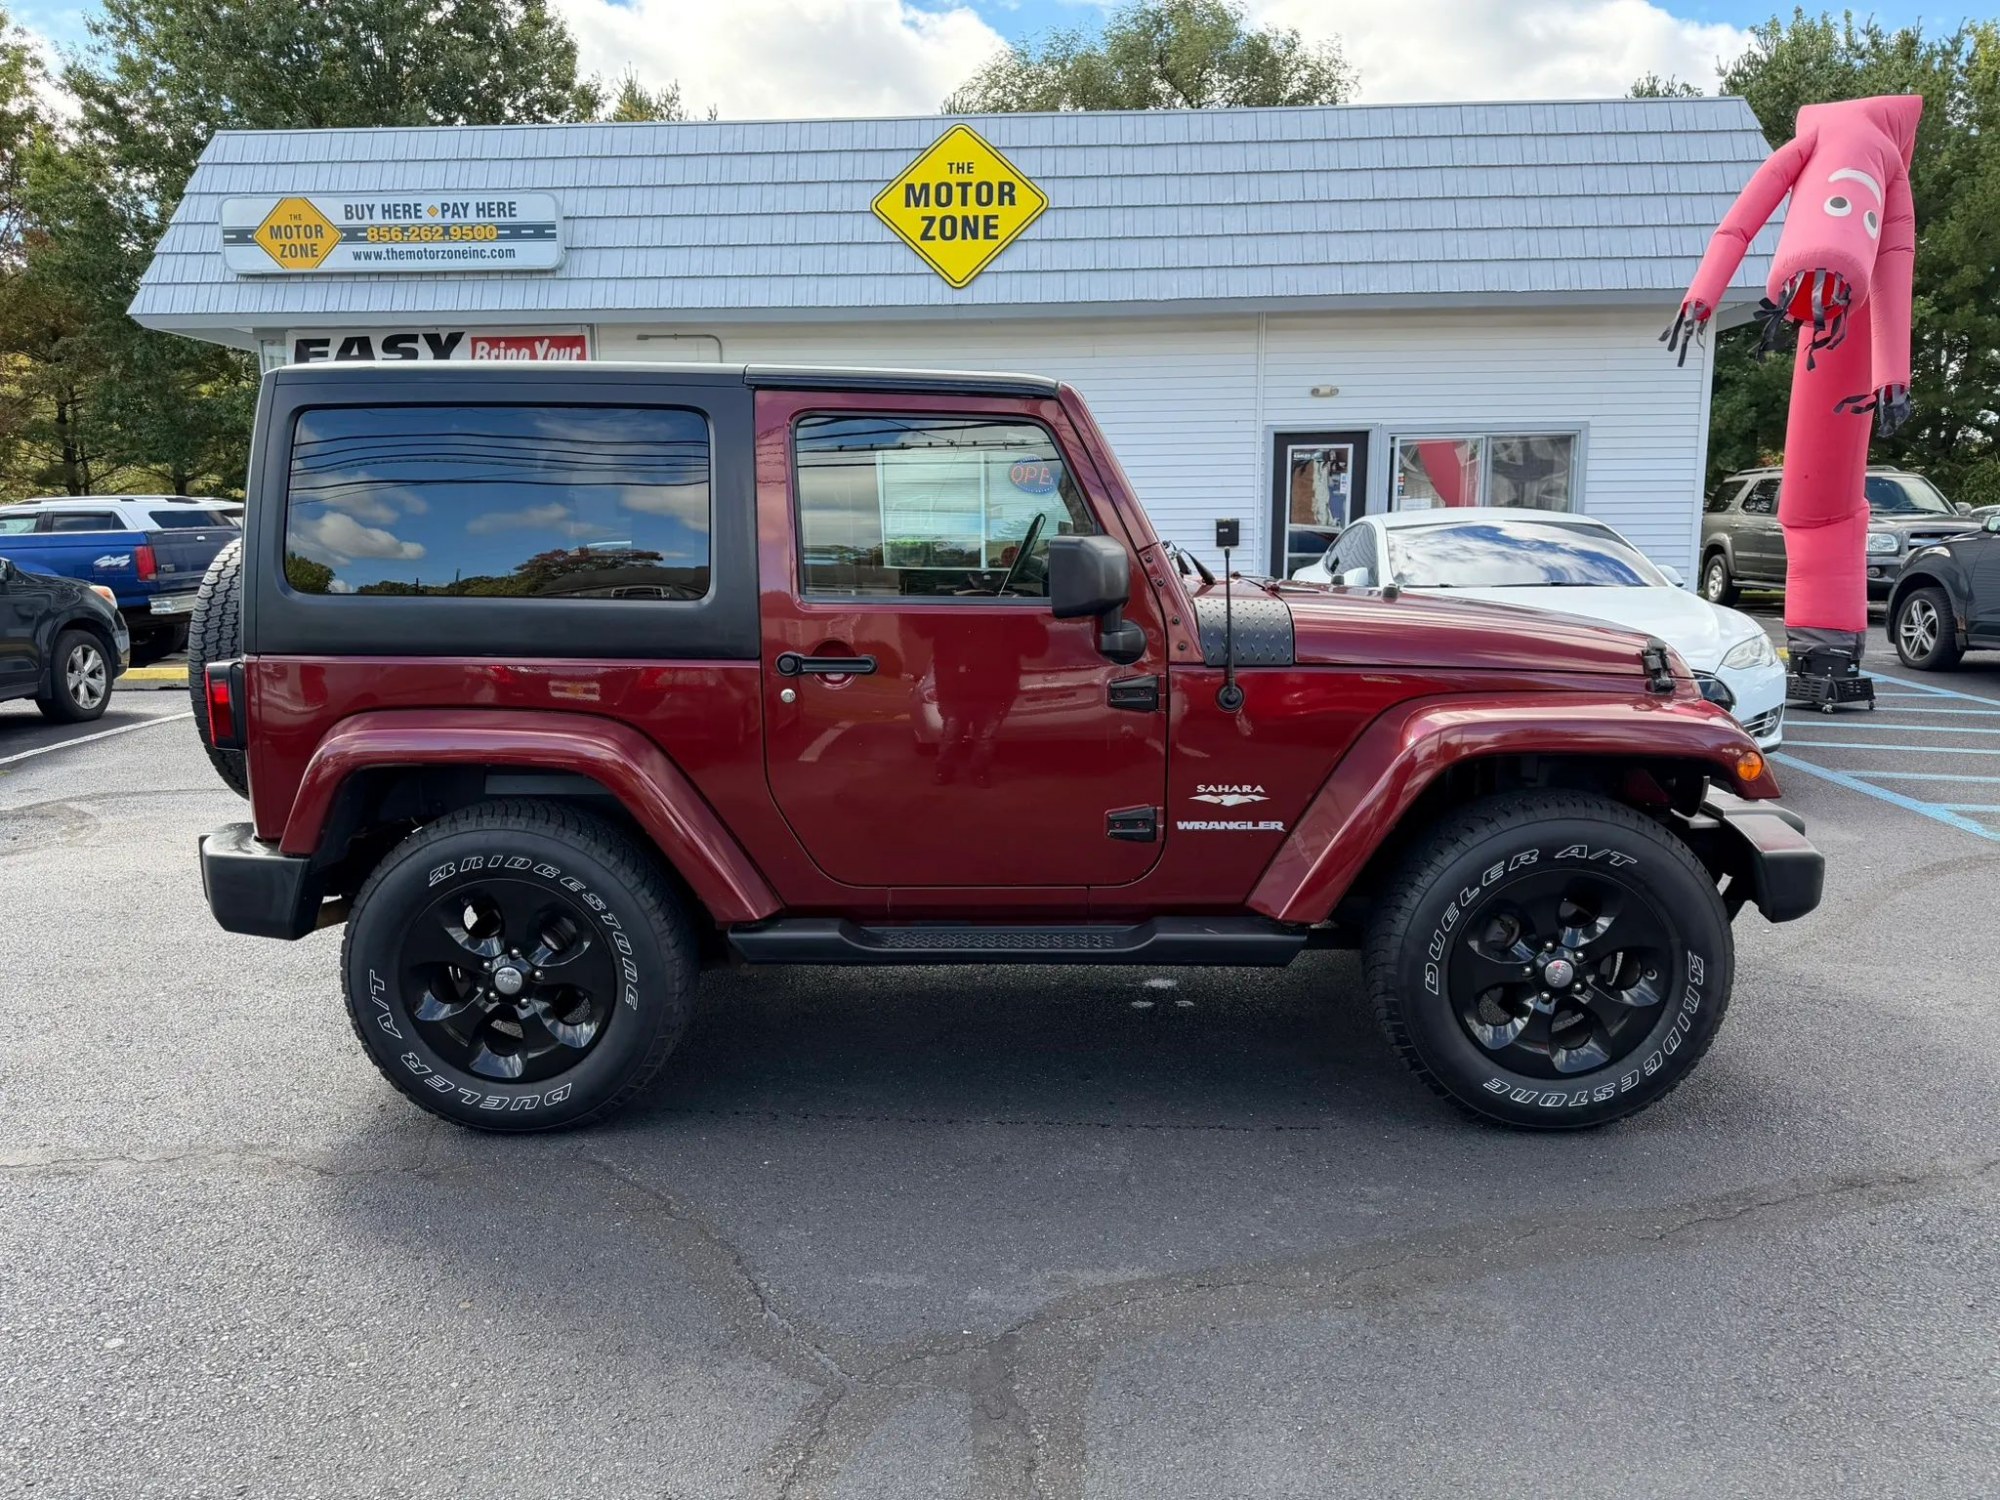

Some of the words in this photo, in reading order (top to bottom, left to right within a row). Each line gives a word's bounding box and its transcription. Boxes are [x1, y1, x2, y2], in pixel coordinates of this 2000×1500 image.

[947, 162, 974, 175] THE
[904, 180, 1017, 208] MOTOR
[288, 213, 302, 221] THE
[344, 203, 376, 220] BUY
[381, 203, 422, 220] HERE
[440, 202, 470, 219] PAY
[475, 201, 517, 218] HERE
[269, 224, 324, 240] MOTOR
[366, 224, 498, 243] 856.262.9500
[919, 214, 999, 241] ZONE
[279, 243, 319, 258] ZONE
[352, 246, 516, 261] www.themotorzoneinc.com
[294, 331, 466, 361] EASY
[1196, 784, 1265, 793] SAHARA
[1176, 820, 1288, 833] WRANGLER
[1423, 847, 1541, 996] DUELER
[1553, 842, 1639, 867] A/T
[428, 854, 639, 1012] BRIDGESTONE
[368, 969, 403, 1040] A/T
[1482, 949, 1705, 1108] BRIDGESTONE
[400, 1050, 574, 1112] DUELER
